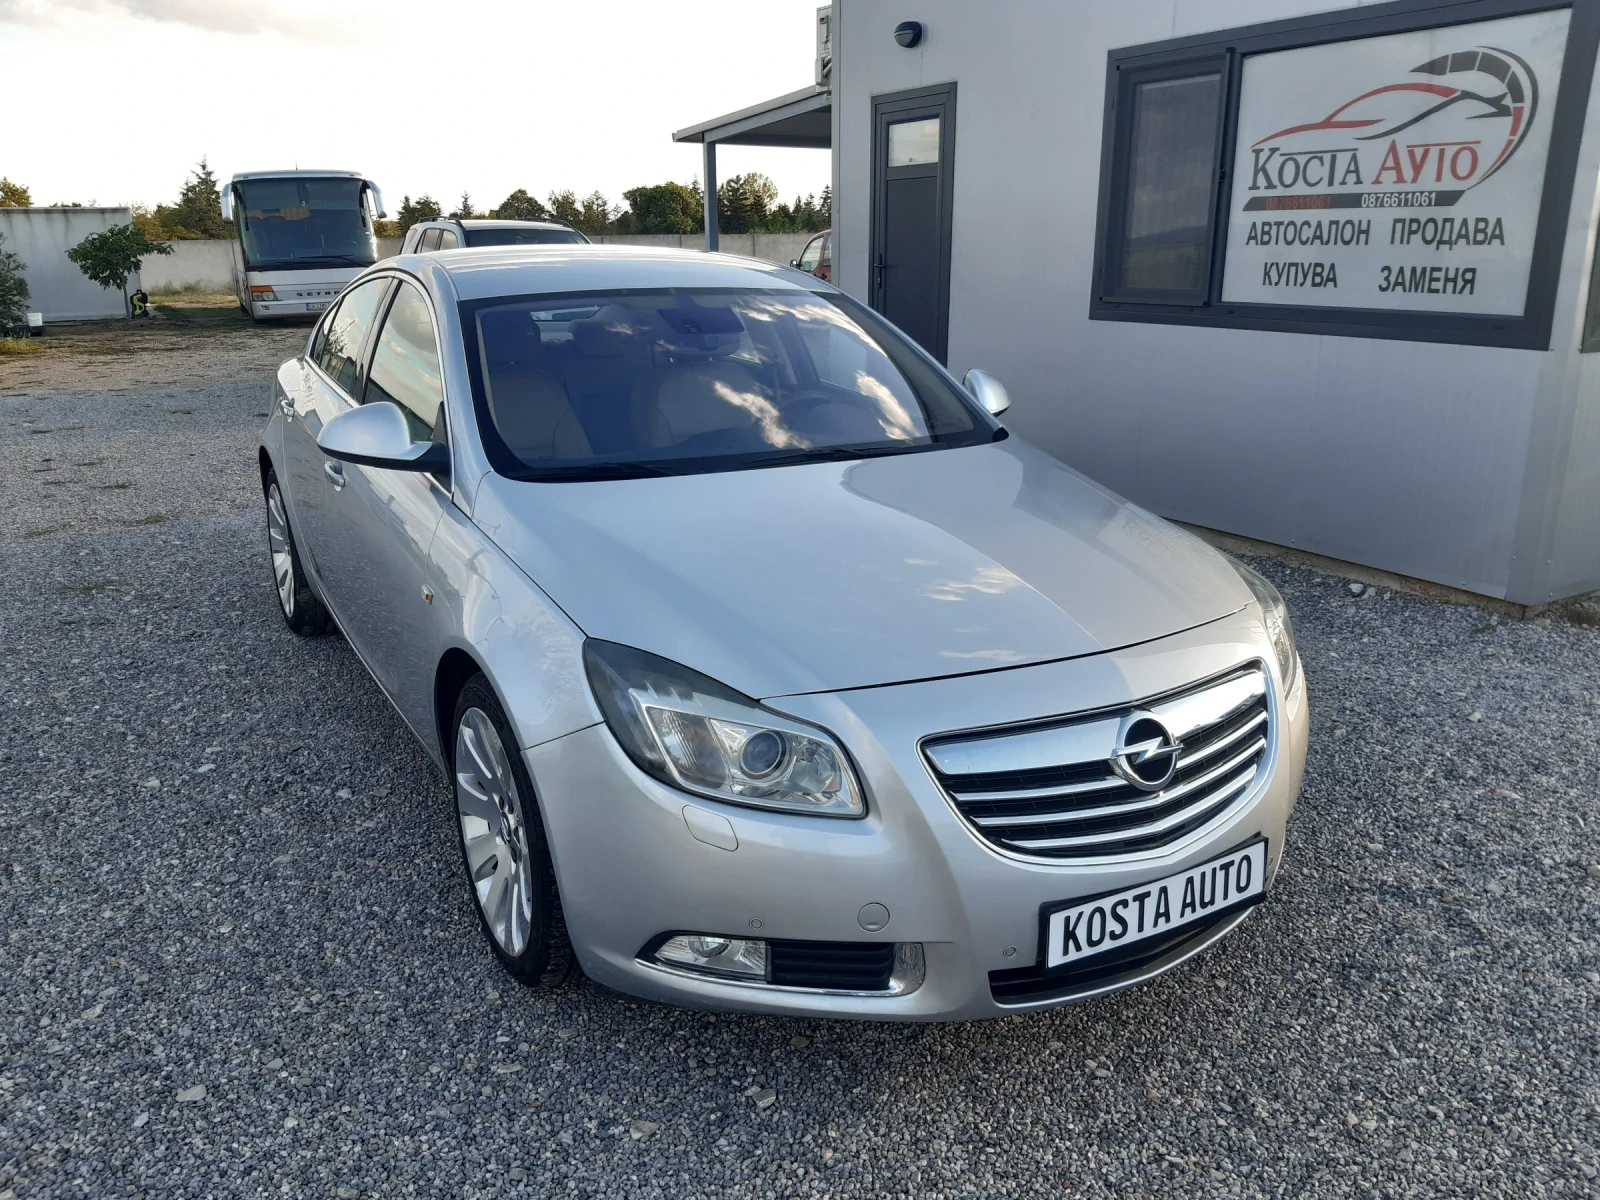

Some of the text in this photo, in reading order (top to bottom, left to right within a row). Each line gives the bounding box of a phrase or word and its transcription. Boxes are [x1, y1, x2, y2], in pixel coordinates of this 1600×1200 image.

[1361, 192, 1436, 208] 0876611061
[1246, 217, 1505, 251] АВТОСАЛОН ПРОДАВА
[1262, 261, 1477, 295] КУПУВА ЗАМЕНЯ
[1062, 854, 1252, 957] KOSTA AUTO
